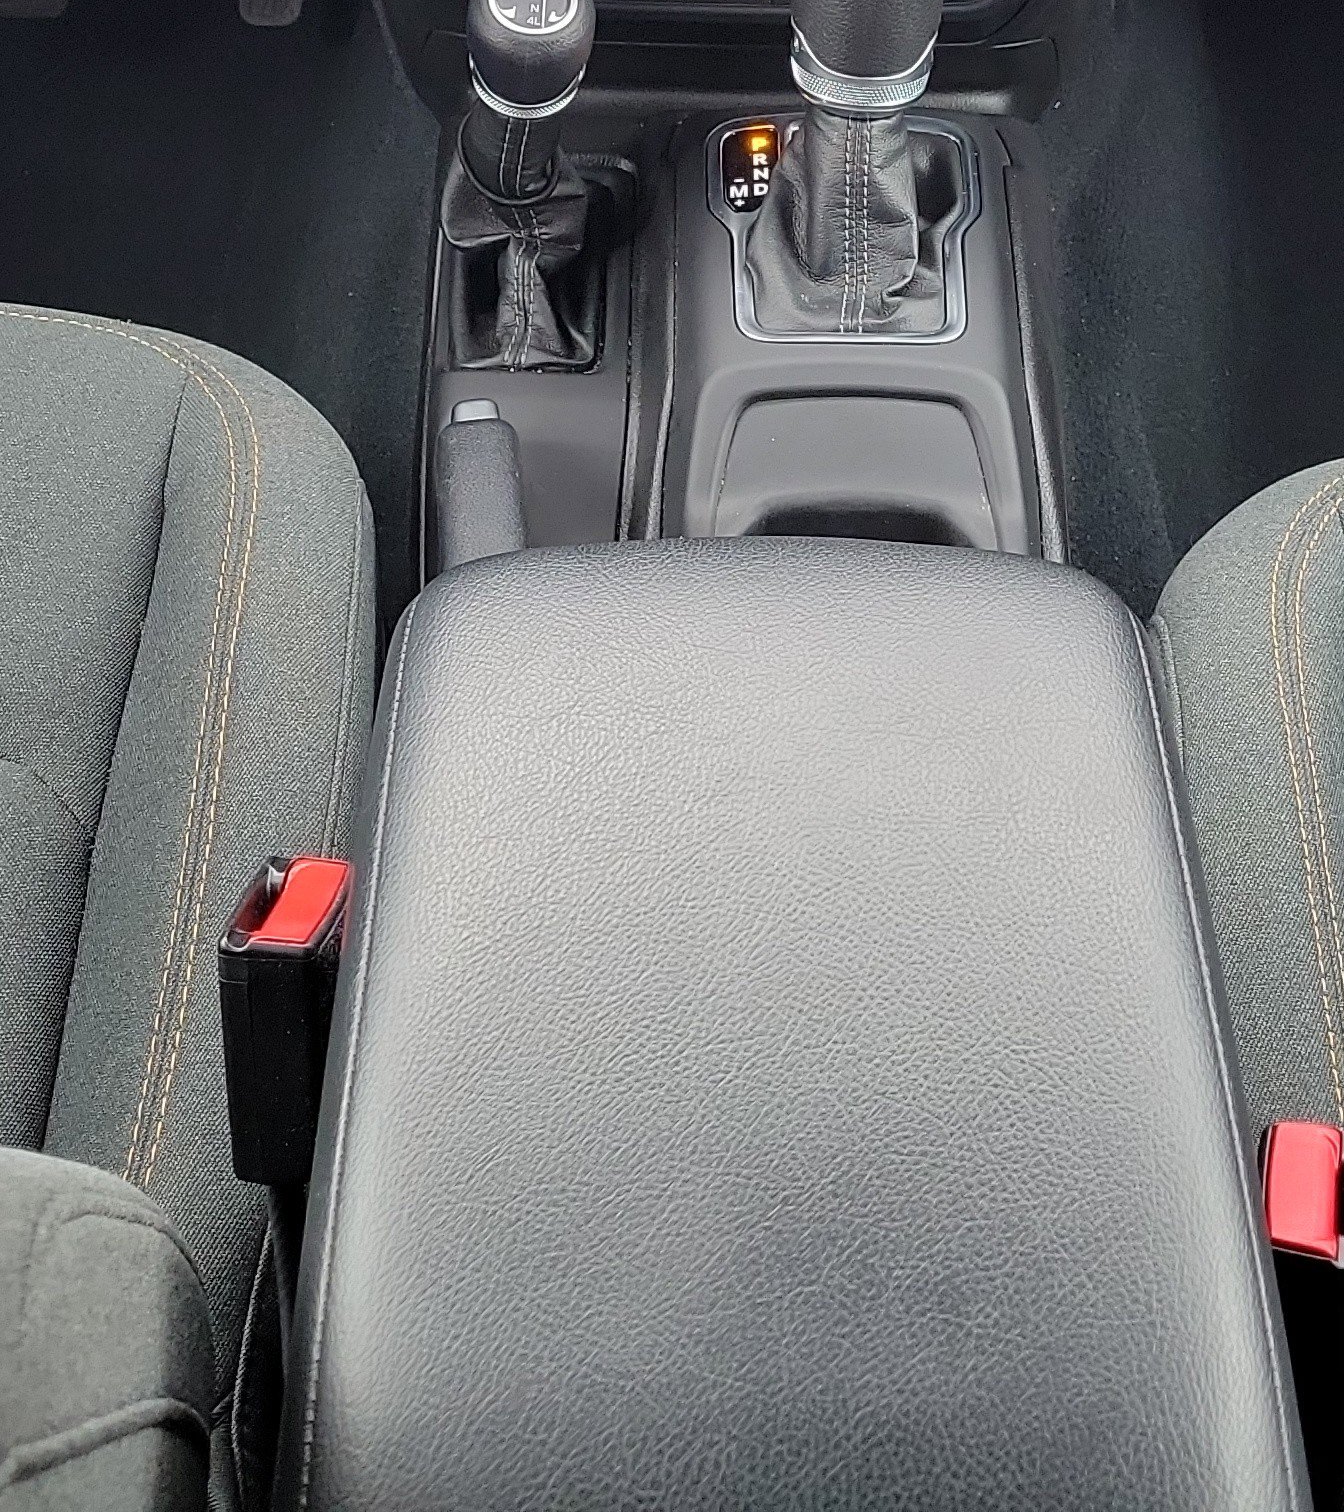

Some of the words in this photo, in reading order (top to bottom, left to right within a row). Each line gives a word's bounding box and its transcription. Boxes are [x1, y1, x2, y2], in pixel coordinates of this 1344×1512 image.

[531, 4, 540, 13] N
[526, 17, 541, 26] 4L
[752, 138, 767, 152] P
[753, 153, 768, 165] R
[753, 168, 768, 180] N
[729, 185, 748, 198] M
[753, 183, 768, 196] D
